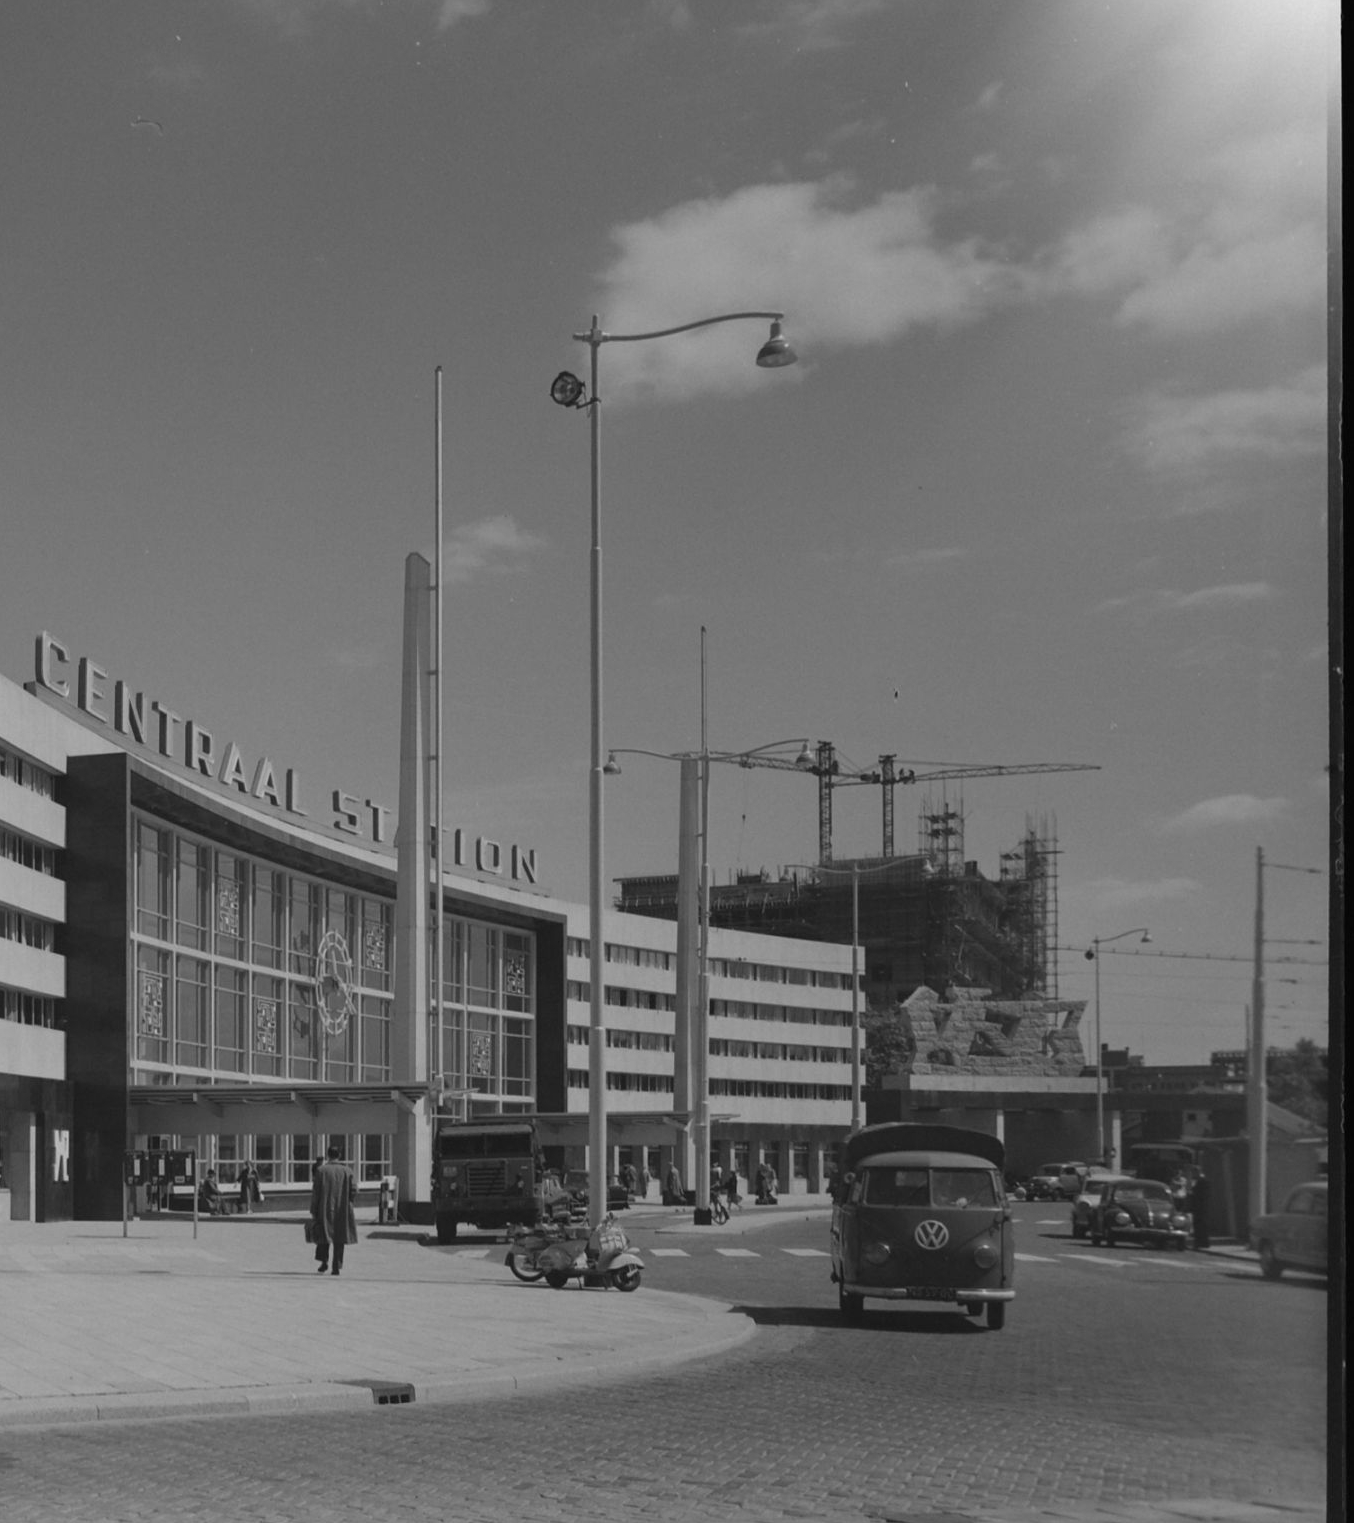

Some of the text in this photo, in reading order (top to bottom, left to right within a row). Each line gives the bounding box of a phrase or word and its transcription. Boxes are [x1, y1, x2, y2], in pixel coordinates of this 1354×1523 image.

[35, 630, 539, 884] CENTRAAL STTION
[916, 1221, 948, 1249] VW
